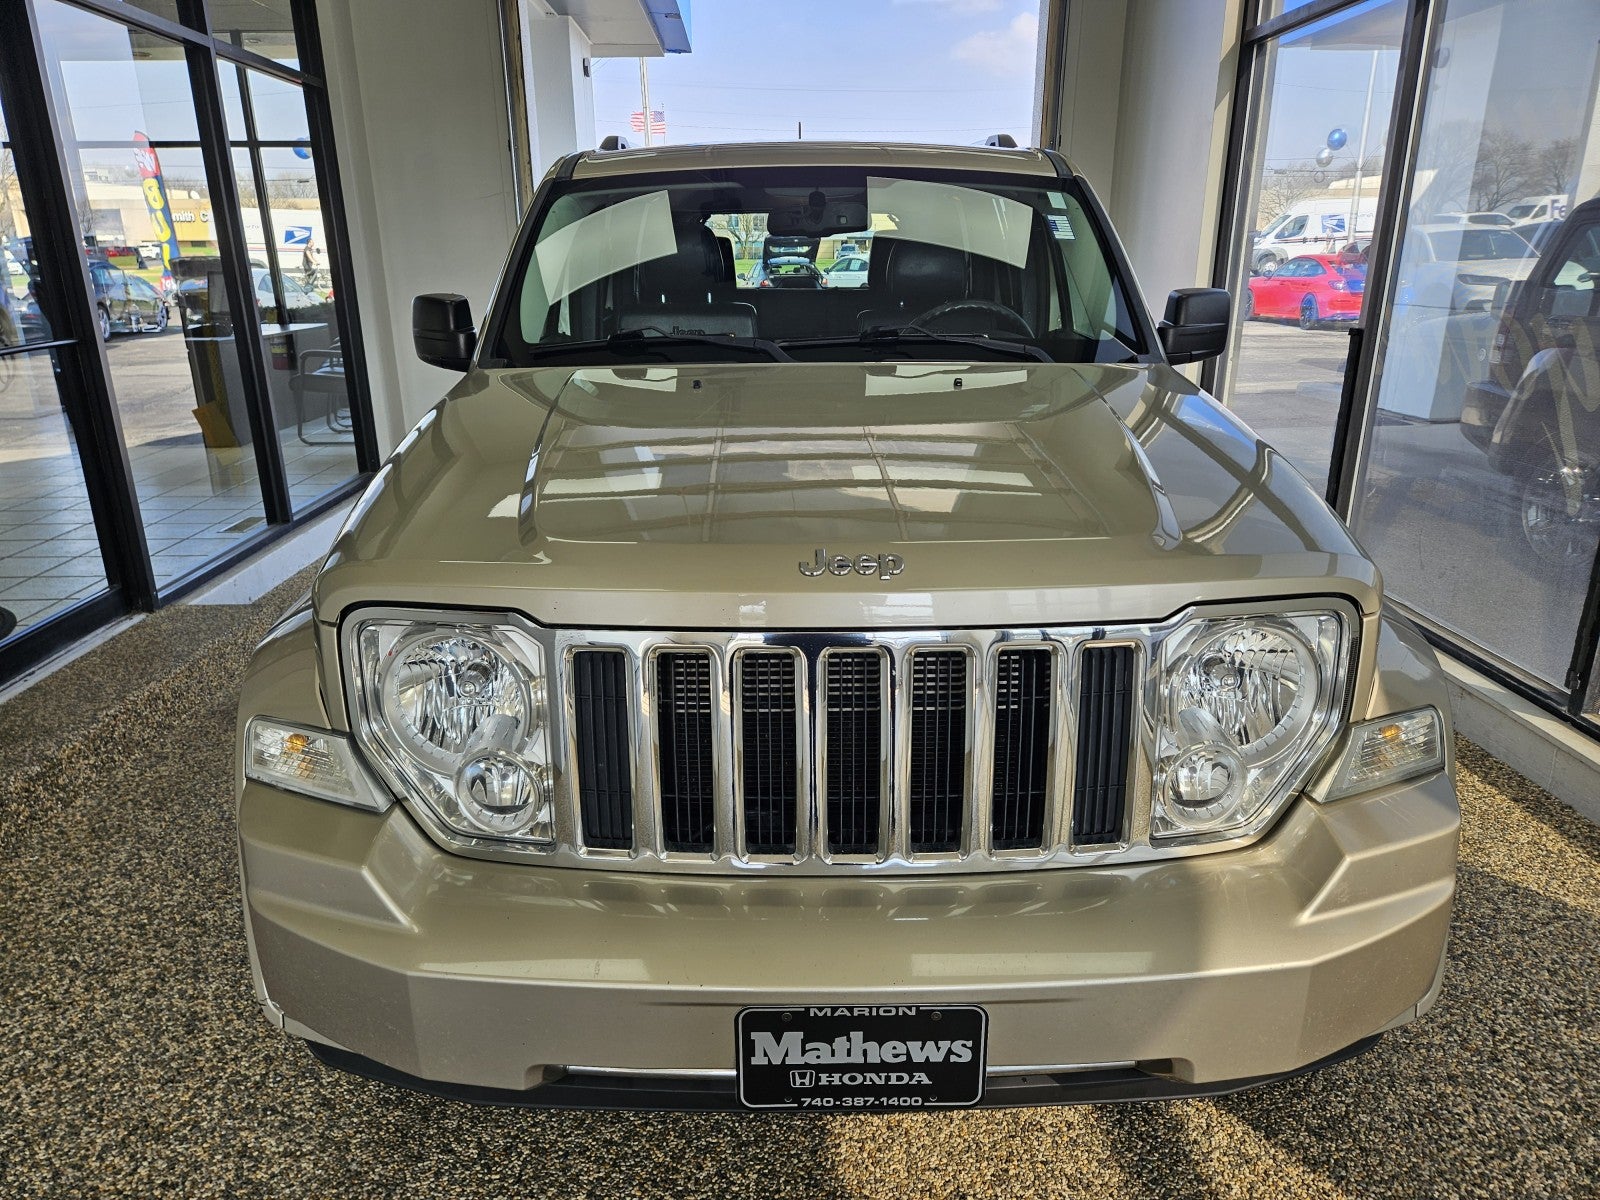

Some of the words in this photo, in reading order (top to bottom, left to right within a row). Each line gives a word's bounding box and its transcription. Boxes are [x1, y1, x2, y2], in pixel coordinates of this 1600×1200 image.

[799, 548, 905, 580] Jeep
[809, 1006, 916, 1017] MARION
[750, 1031, 973, 1065] Mathews
[818, 1072, 932, 1086] HONDA
[800, 1097, 922, 1107] 740-387-1400
